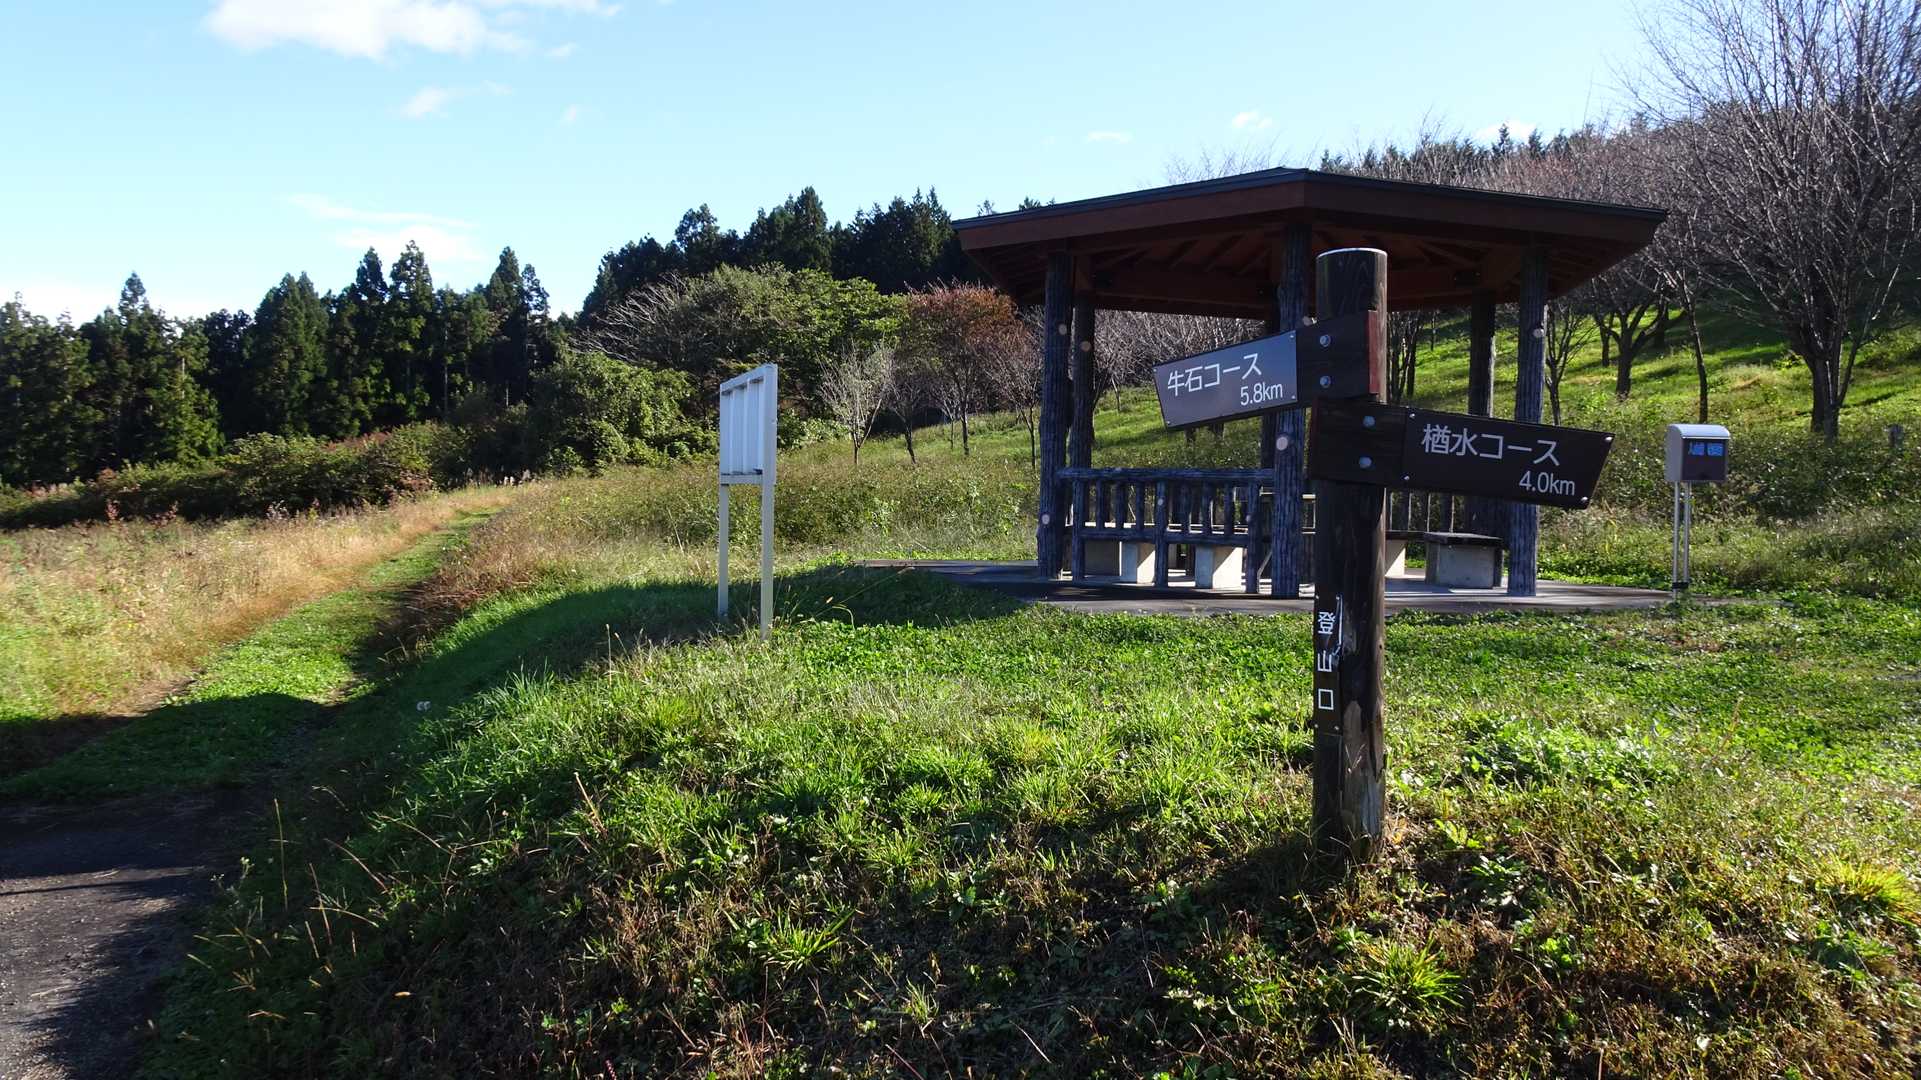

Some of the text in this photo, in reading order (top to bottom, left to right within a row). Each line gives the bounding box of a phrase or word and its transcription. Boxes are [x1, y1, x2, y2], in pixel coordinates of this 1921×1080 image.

[1167, 353, 1262, 397] 牛石コース
[1240, 383, 1284, 406] 5.8km
[1421, 423, 1561, 467] 楢水コース
[1518, 470, 1576, 496] 4.0km
[1317, 611, 1336, 710] 登山口
